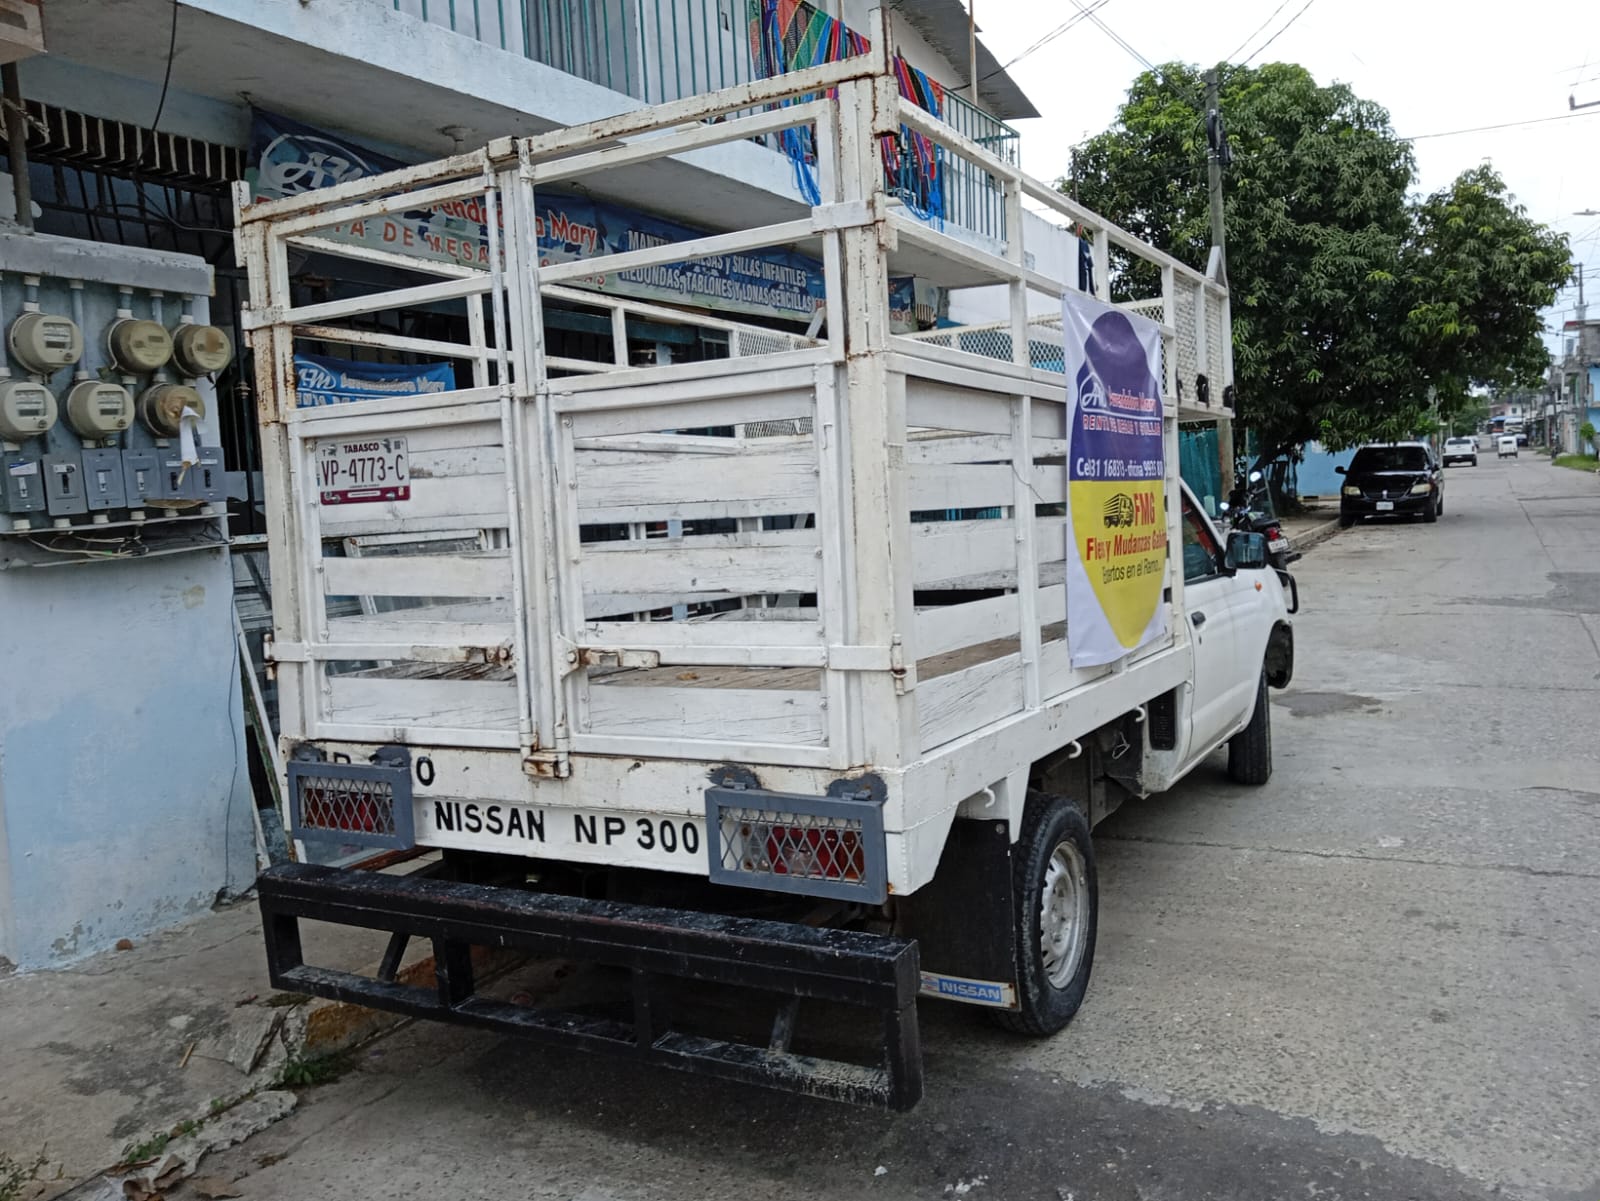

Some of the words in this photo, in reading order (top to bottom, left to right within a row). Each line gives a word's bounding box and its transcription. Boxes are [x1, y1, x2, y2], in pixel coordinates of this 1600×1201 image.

[383, 221, 414, 247] DE
[547, 209, 597, 253] Mary
[733, 255, 761, 279] SILLAS
[762, 261, 807, 288] INFANTILES
[686, 271, 732, 298] TABLONES
[742, 284, 769, 306] LONAS
[343, 442, 380, 454] TABASCO
[320, 453, 405, 486] VP-4773-C
[1133, 492, 1155, 527] FMG
[434, 800, 546, 843] NISSAN
[941, 981, 1000, 1000] NISSAN
